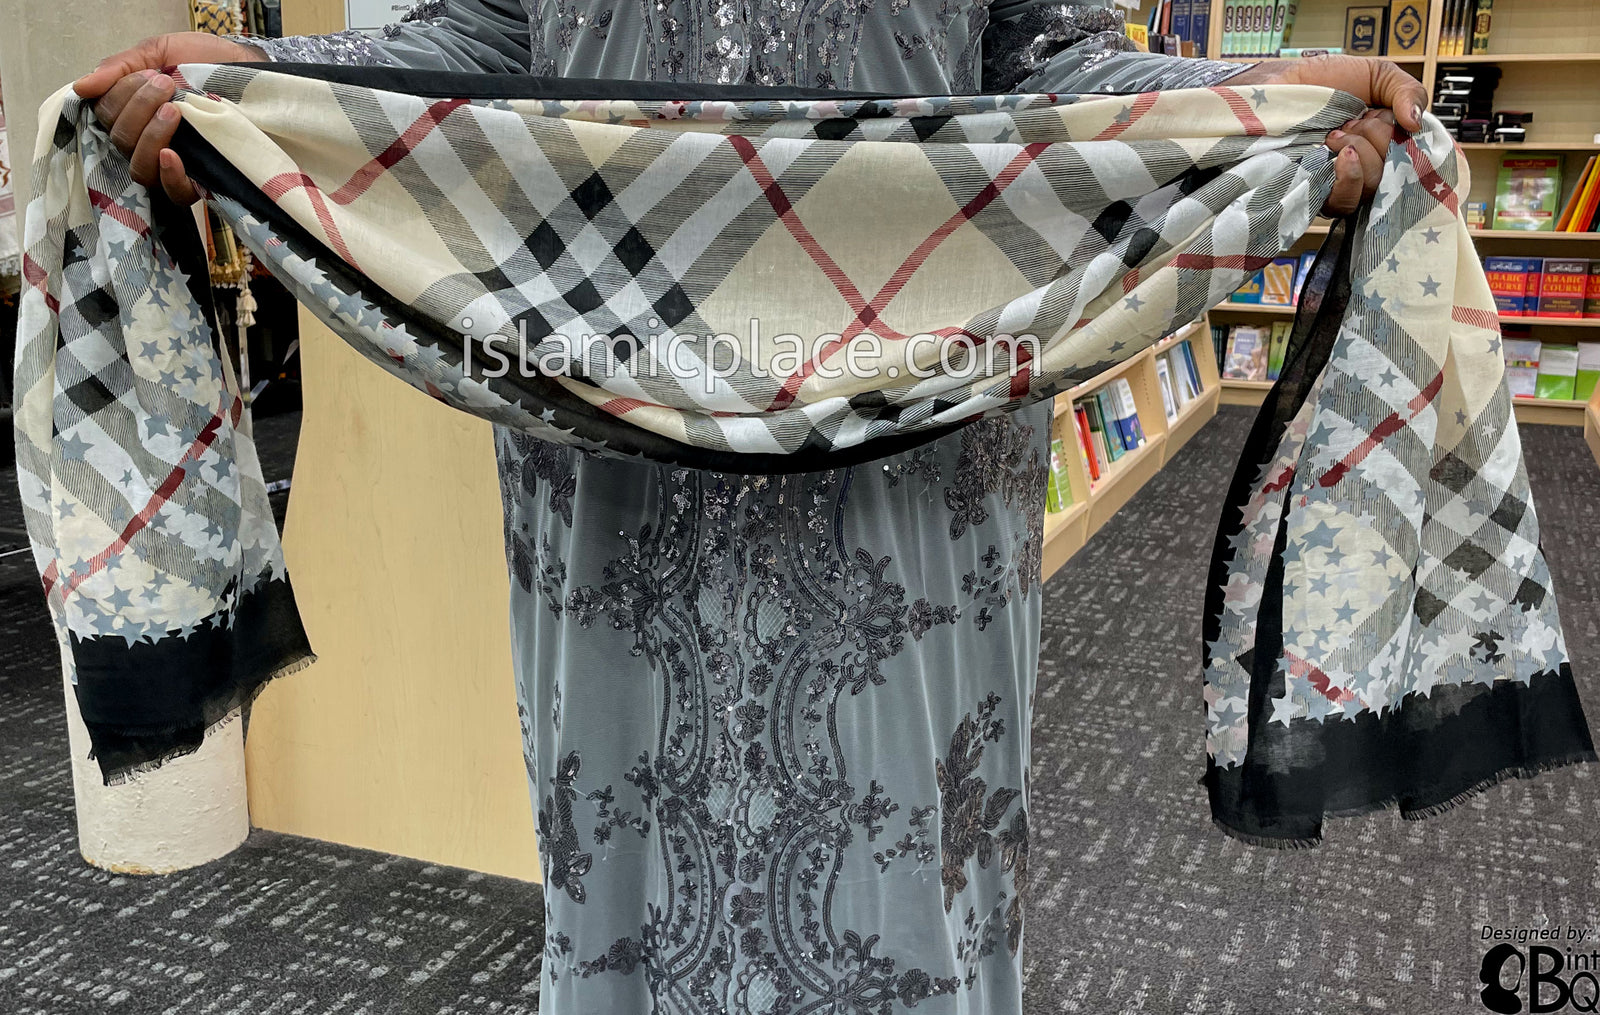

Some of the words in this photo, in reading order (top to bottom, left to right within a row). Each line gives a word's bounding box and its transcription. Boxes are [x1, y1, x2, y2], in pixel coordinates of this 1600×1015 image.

[1545, 275, 1584, 283] ARABIC
[1491, 282, 1522, 290] OURSE
[1543, 284, 1581, 292] COURSE
